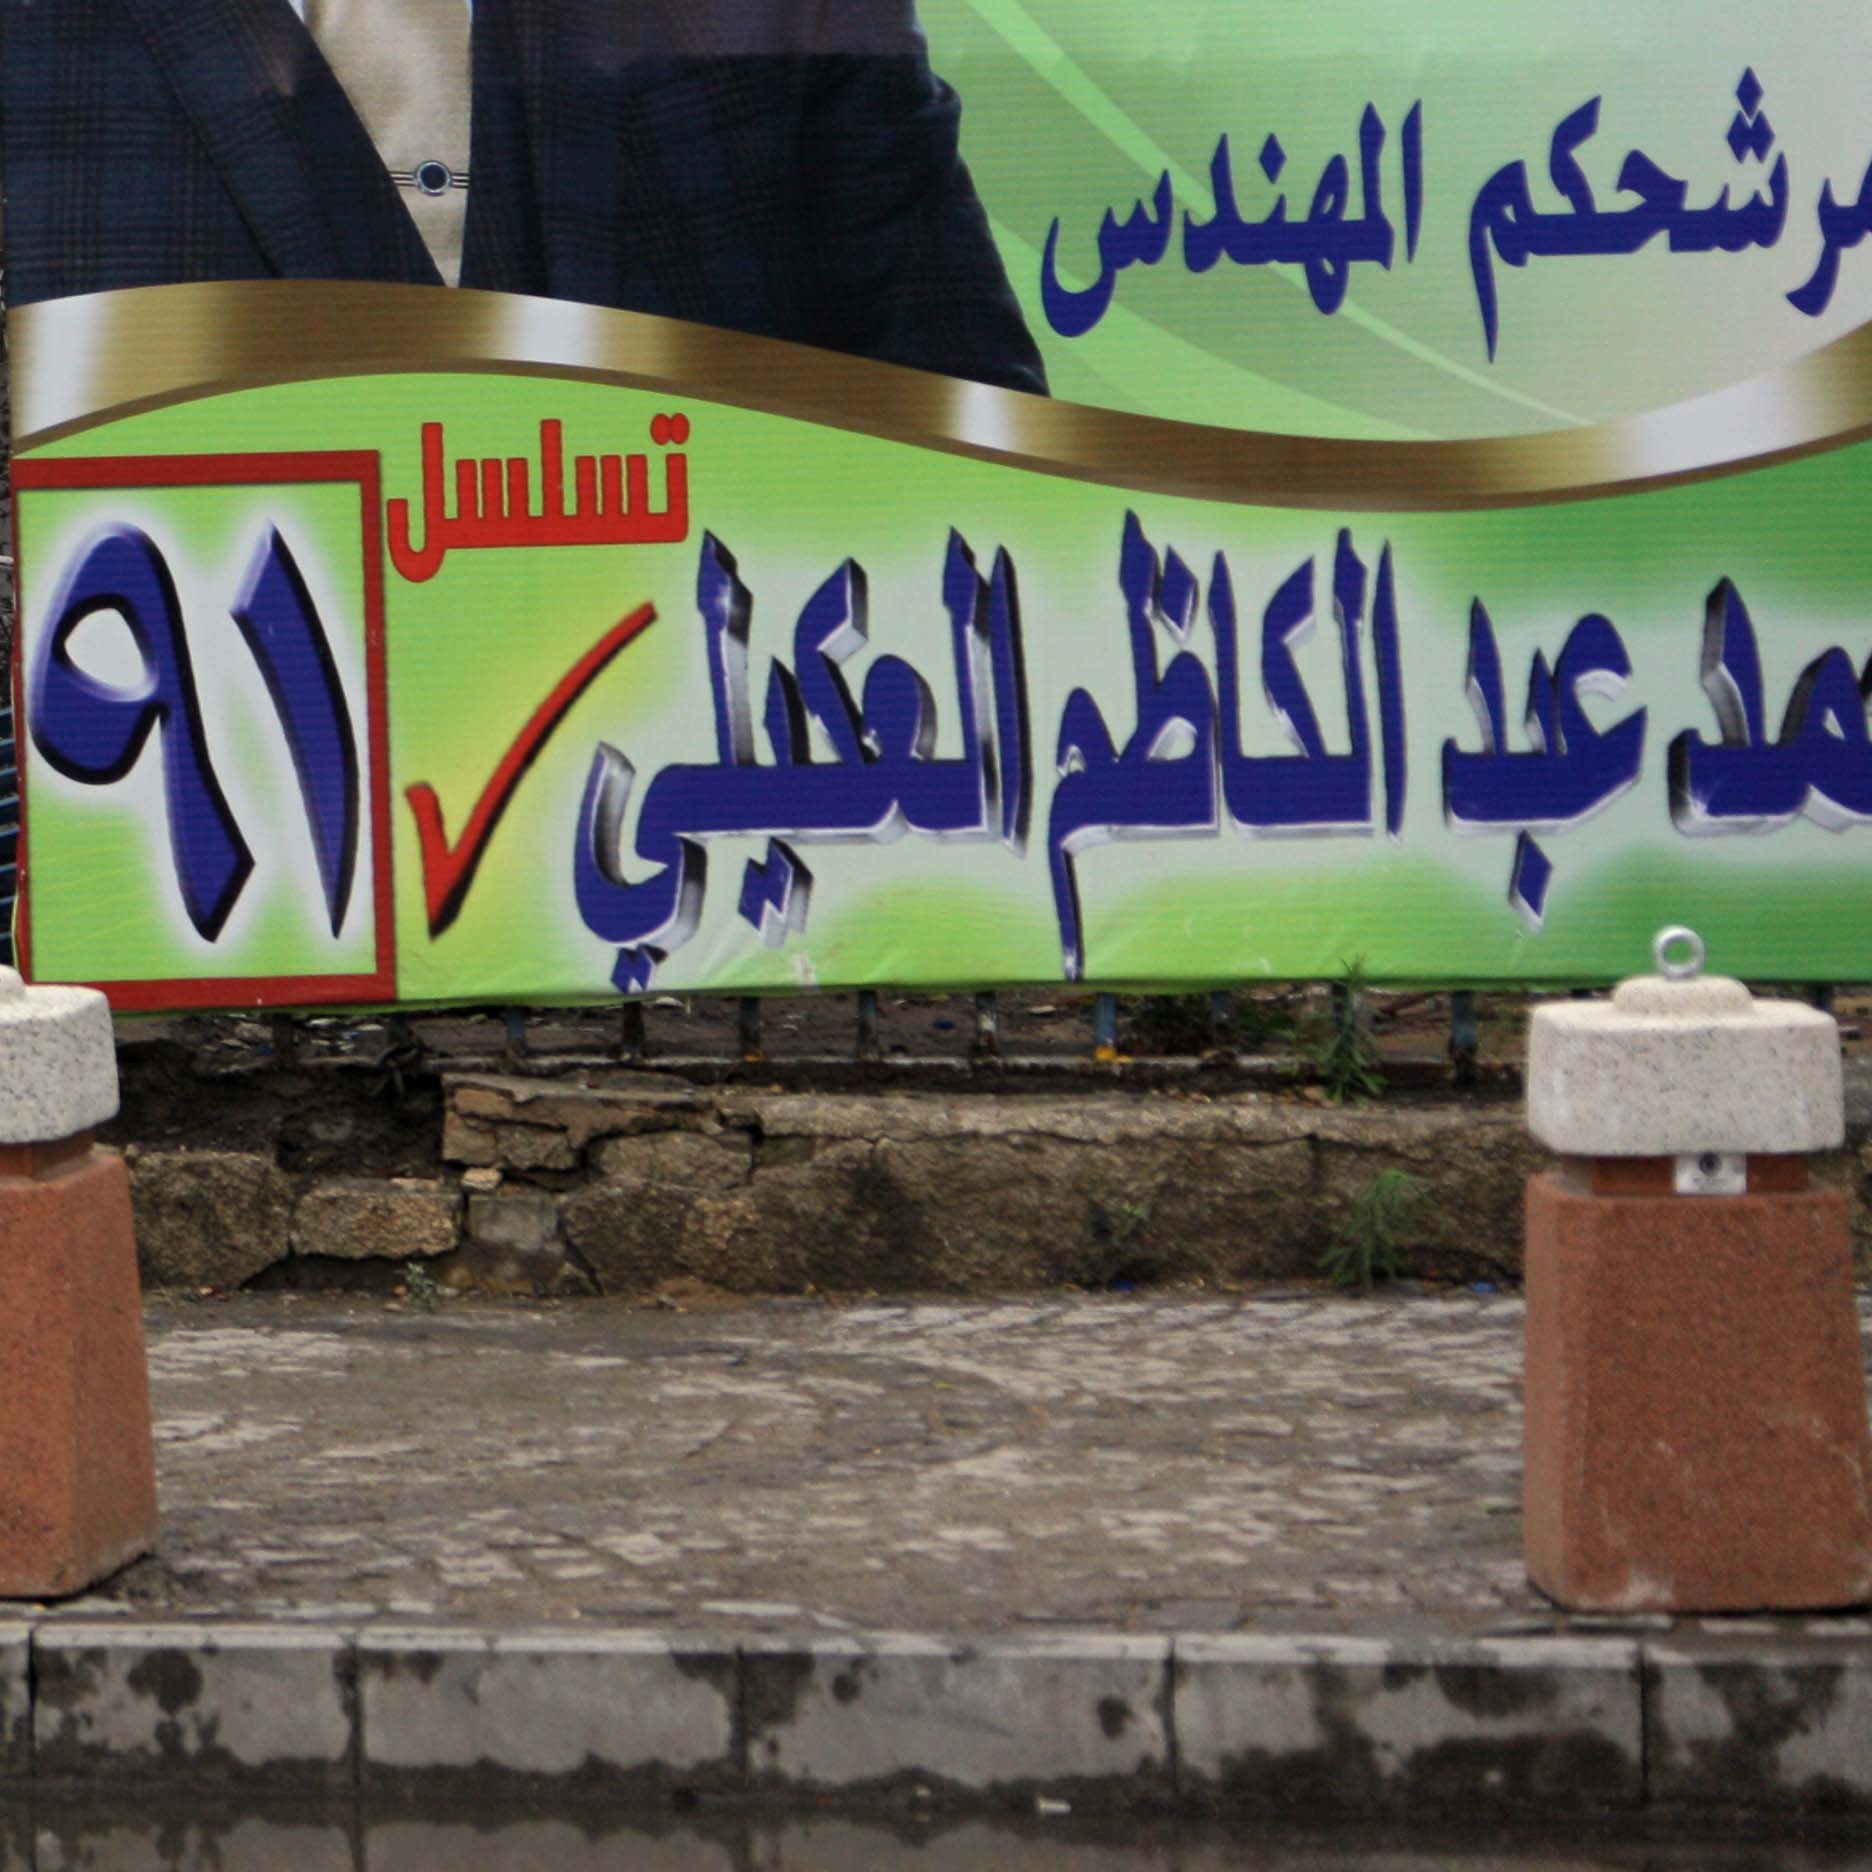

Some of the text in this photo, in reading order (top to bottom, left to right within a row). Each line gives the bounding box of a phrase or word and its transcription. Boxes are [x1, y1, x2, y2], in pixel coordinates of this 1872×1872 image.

[1041, 98, 1423, 339] المهندس
[388, 414, 691, 583] تسلسل
[30, 520, 363, 945] ٩١
[573, 523, 1033, 995] العكيلي
[1047, 506, 1404, 982] الكاظم
[1442, 593, 1651, 934] عبد
